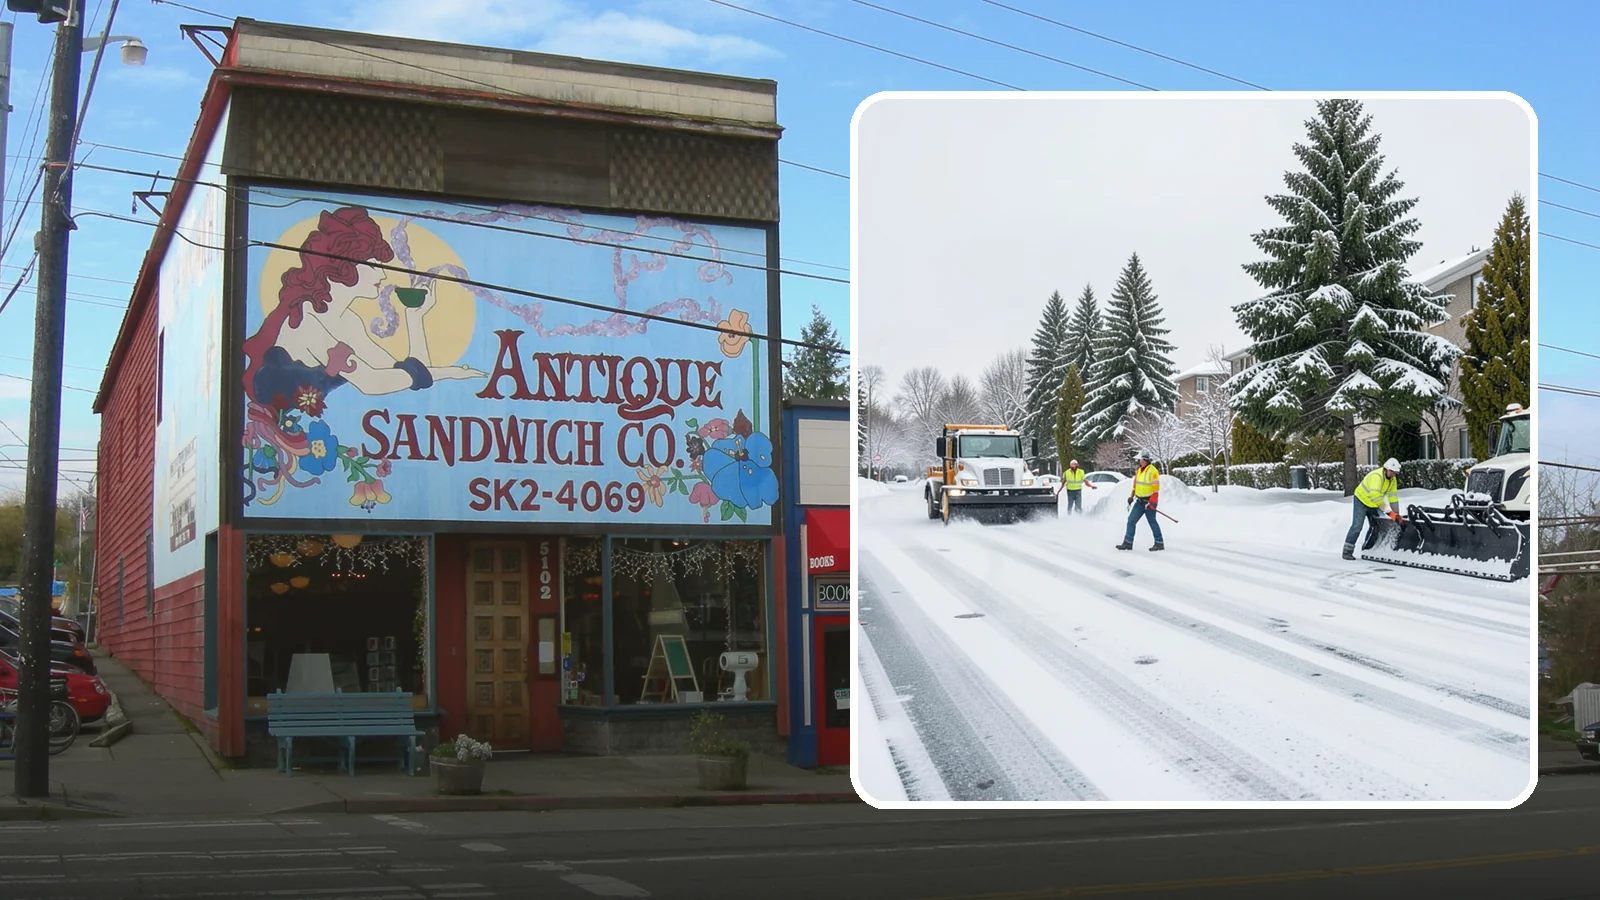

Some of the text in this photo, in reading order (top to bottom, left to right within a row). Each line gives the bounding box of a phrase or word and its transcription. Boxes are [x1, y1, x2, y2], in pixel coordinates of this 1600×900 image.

[476, 329, 723, 420] ANTIQUE
[361, 408, 685, 469] SANDWICH CO.
[469, 477, 646, 513] SK2-4069
[540, 541, 551, 599] 5102
[809, 555, 835, 569] BOOKS
